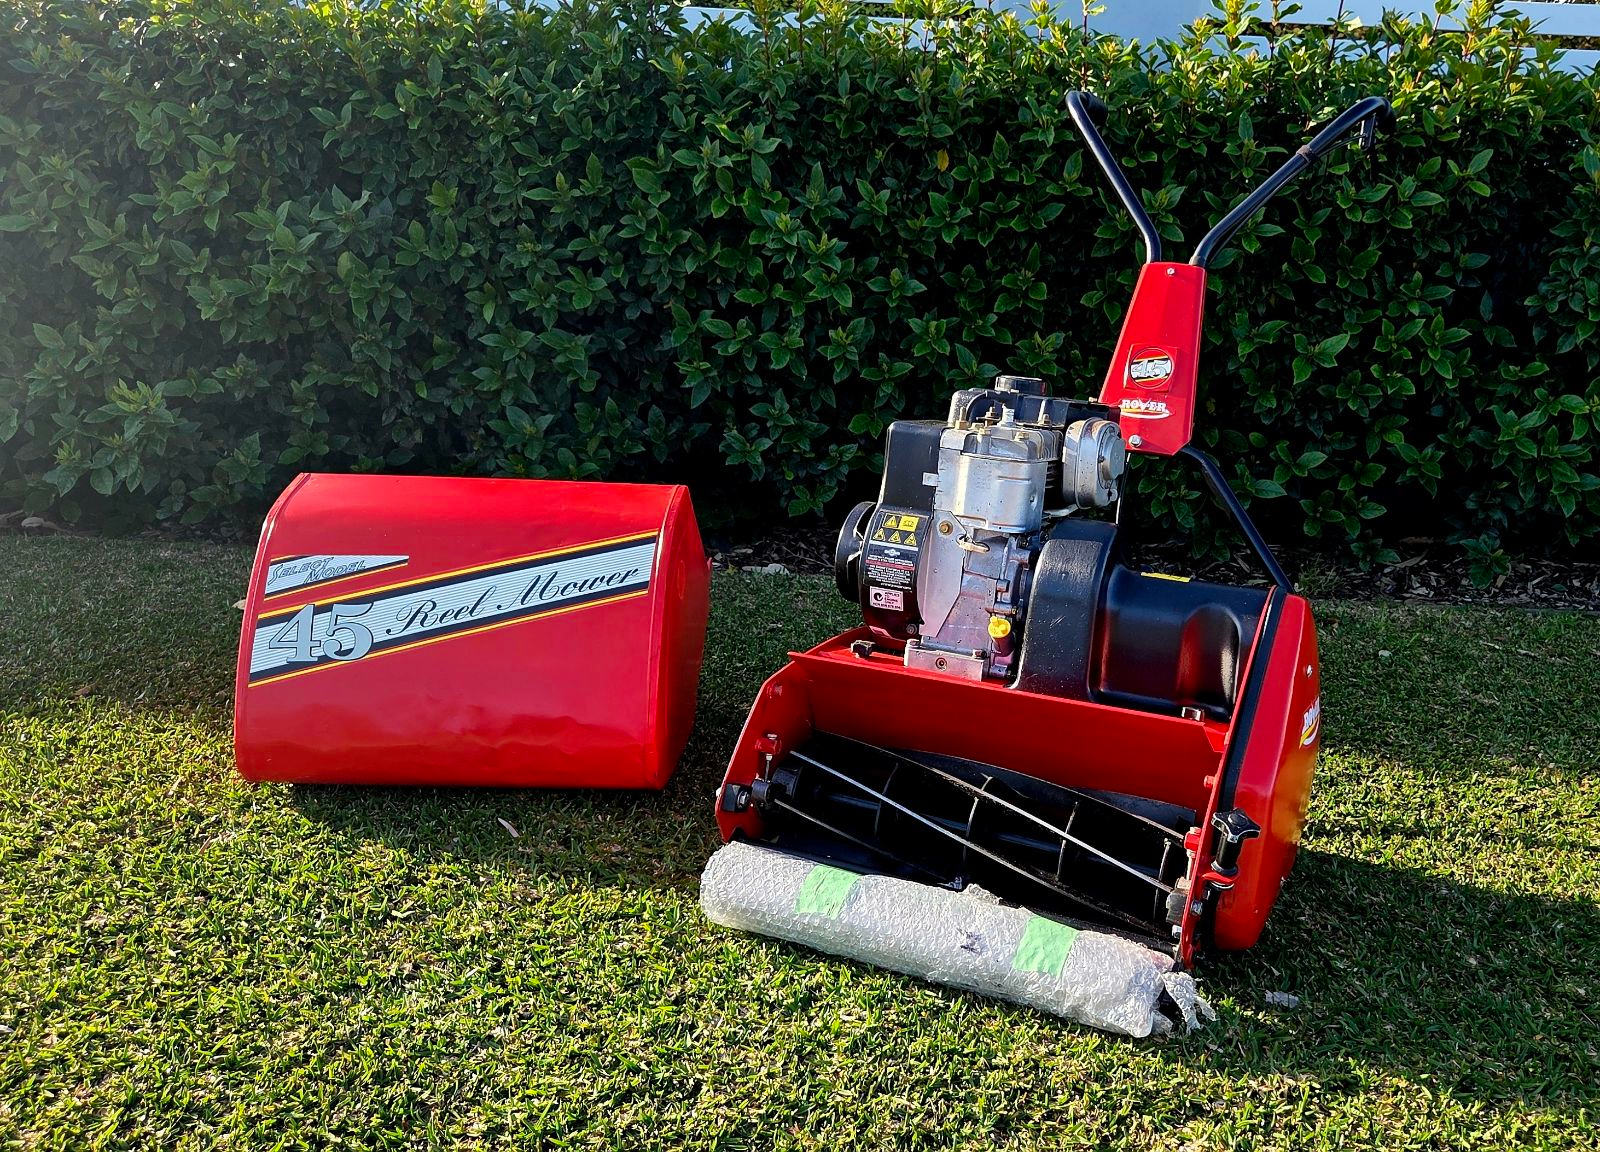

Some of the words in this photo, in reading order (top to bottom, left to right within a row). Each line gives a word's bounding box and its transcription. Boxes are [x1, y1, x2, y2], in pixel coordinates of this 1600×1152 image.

[1132, 359, 1168, 378] 45
[1120, 398, 1168, 414] ROVER
[268, 556, 333, 586] SELECT
[303, 559, 367, 584] MODEL
[267, 602, 375, 664] 45
[385, 586, 495, 636] Reel
[496, 566, 640, 611] Mower
